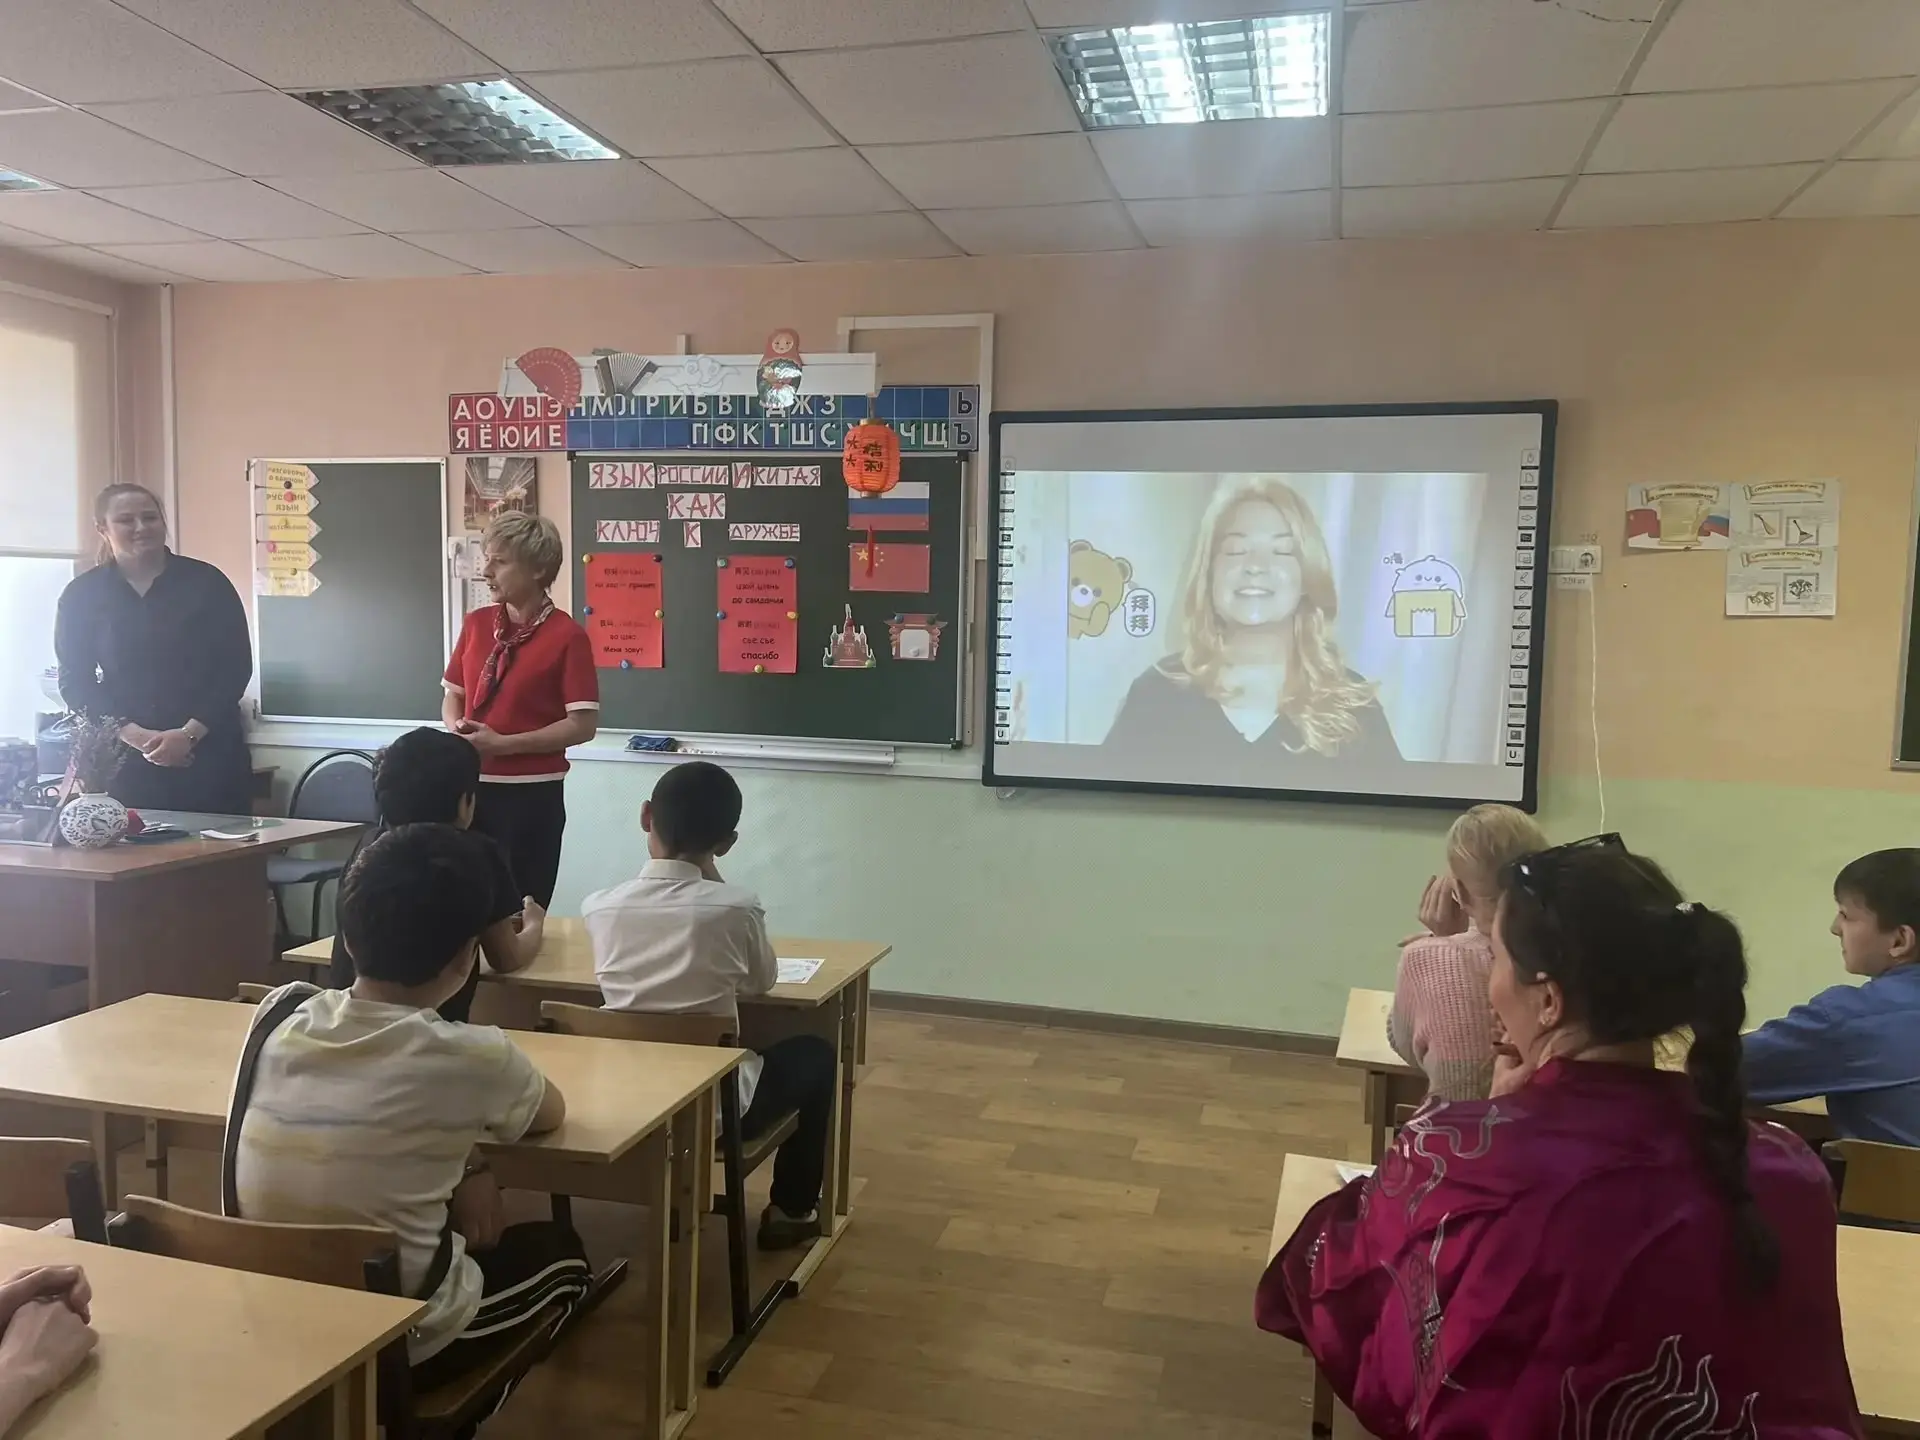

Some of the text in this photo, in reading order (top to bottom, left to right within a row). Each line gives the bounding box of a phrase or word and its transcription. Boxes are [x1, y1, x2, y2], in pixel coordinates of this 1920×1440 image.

[590, 463, 820, 488] ЯЗЫК РОССИИ И КИТАЯ
[669, 494, 725, 519] КАК
[597, 521, 799, 547] КЛЮЧ К ДРУЖБЕ
[741, 651, 780, 660] спасибо
